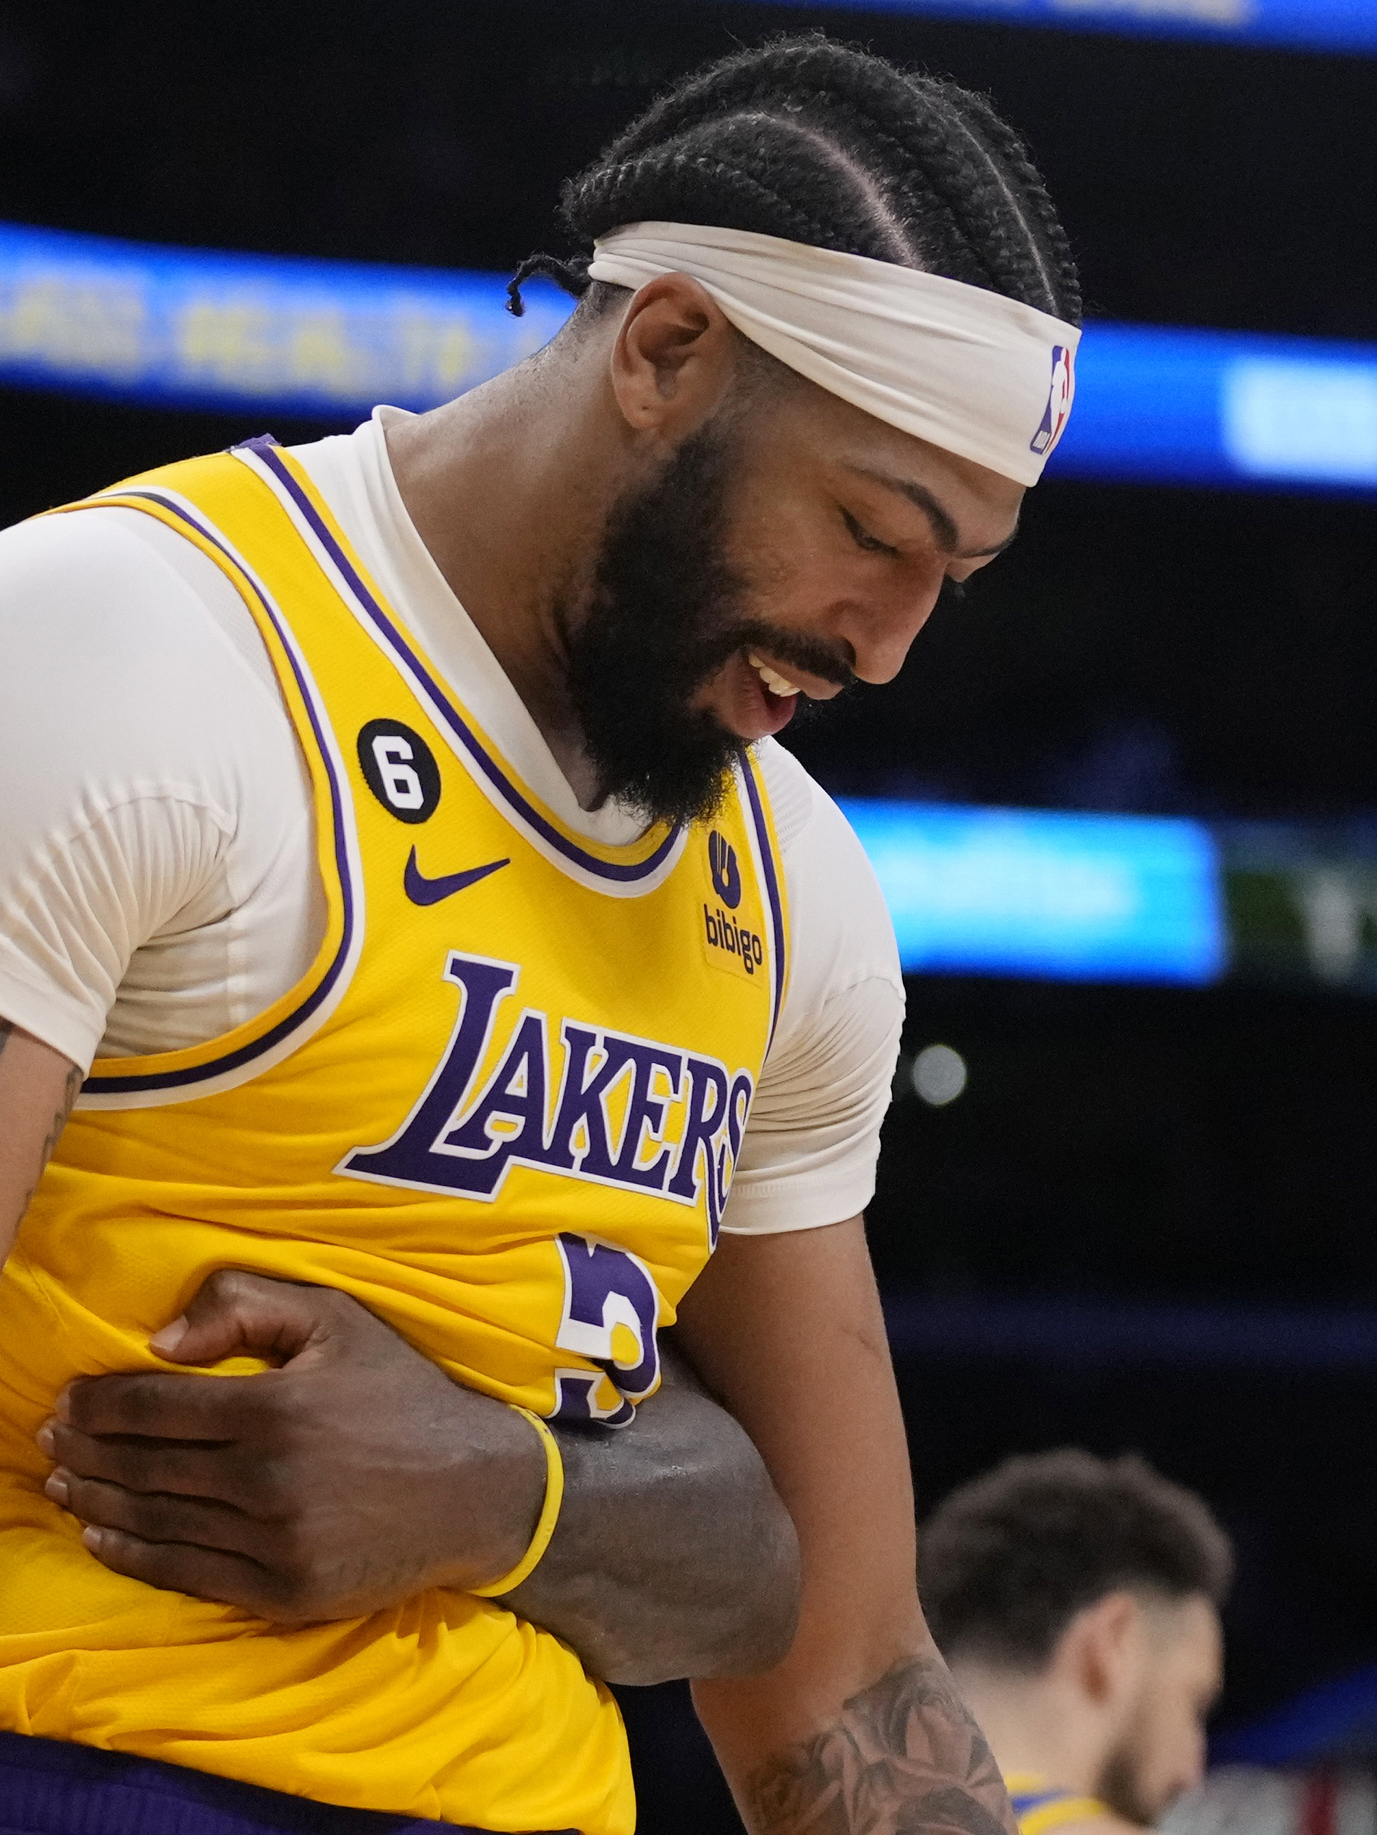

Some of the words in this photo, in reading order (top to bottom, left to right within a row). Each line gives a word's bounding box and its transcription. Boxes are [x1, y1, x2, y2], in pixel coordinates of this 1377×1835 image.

[371, 735, 424, 810] 6
[703, 902, 763, 975] bibigo
[332, 949, 754, 1255] LAKERS
